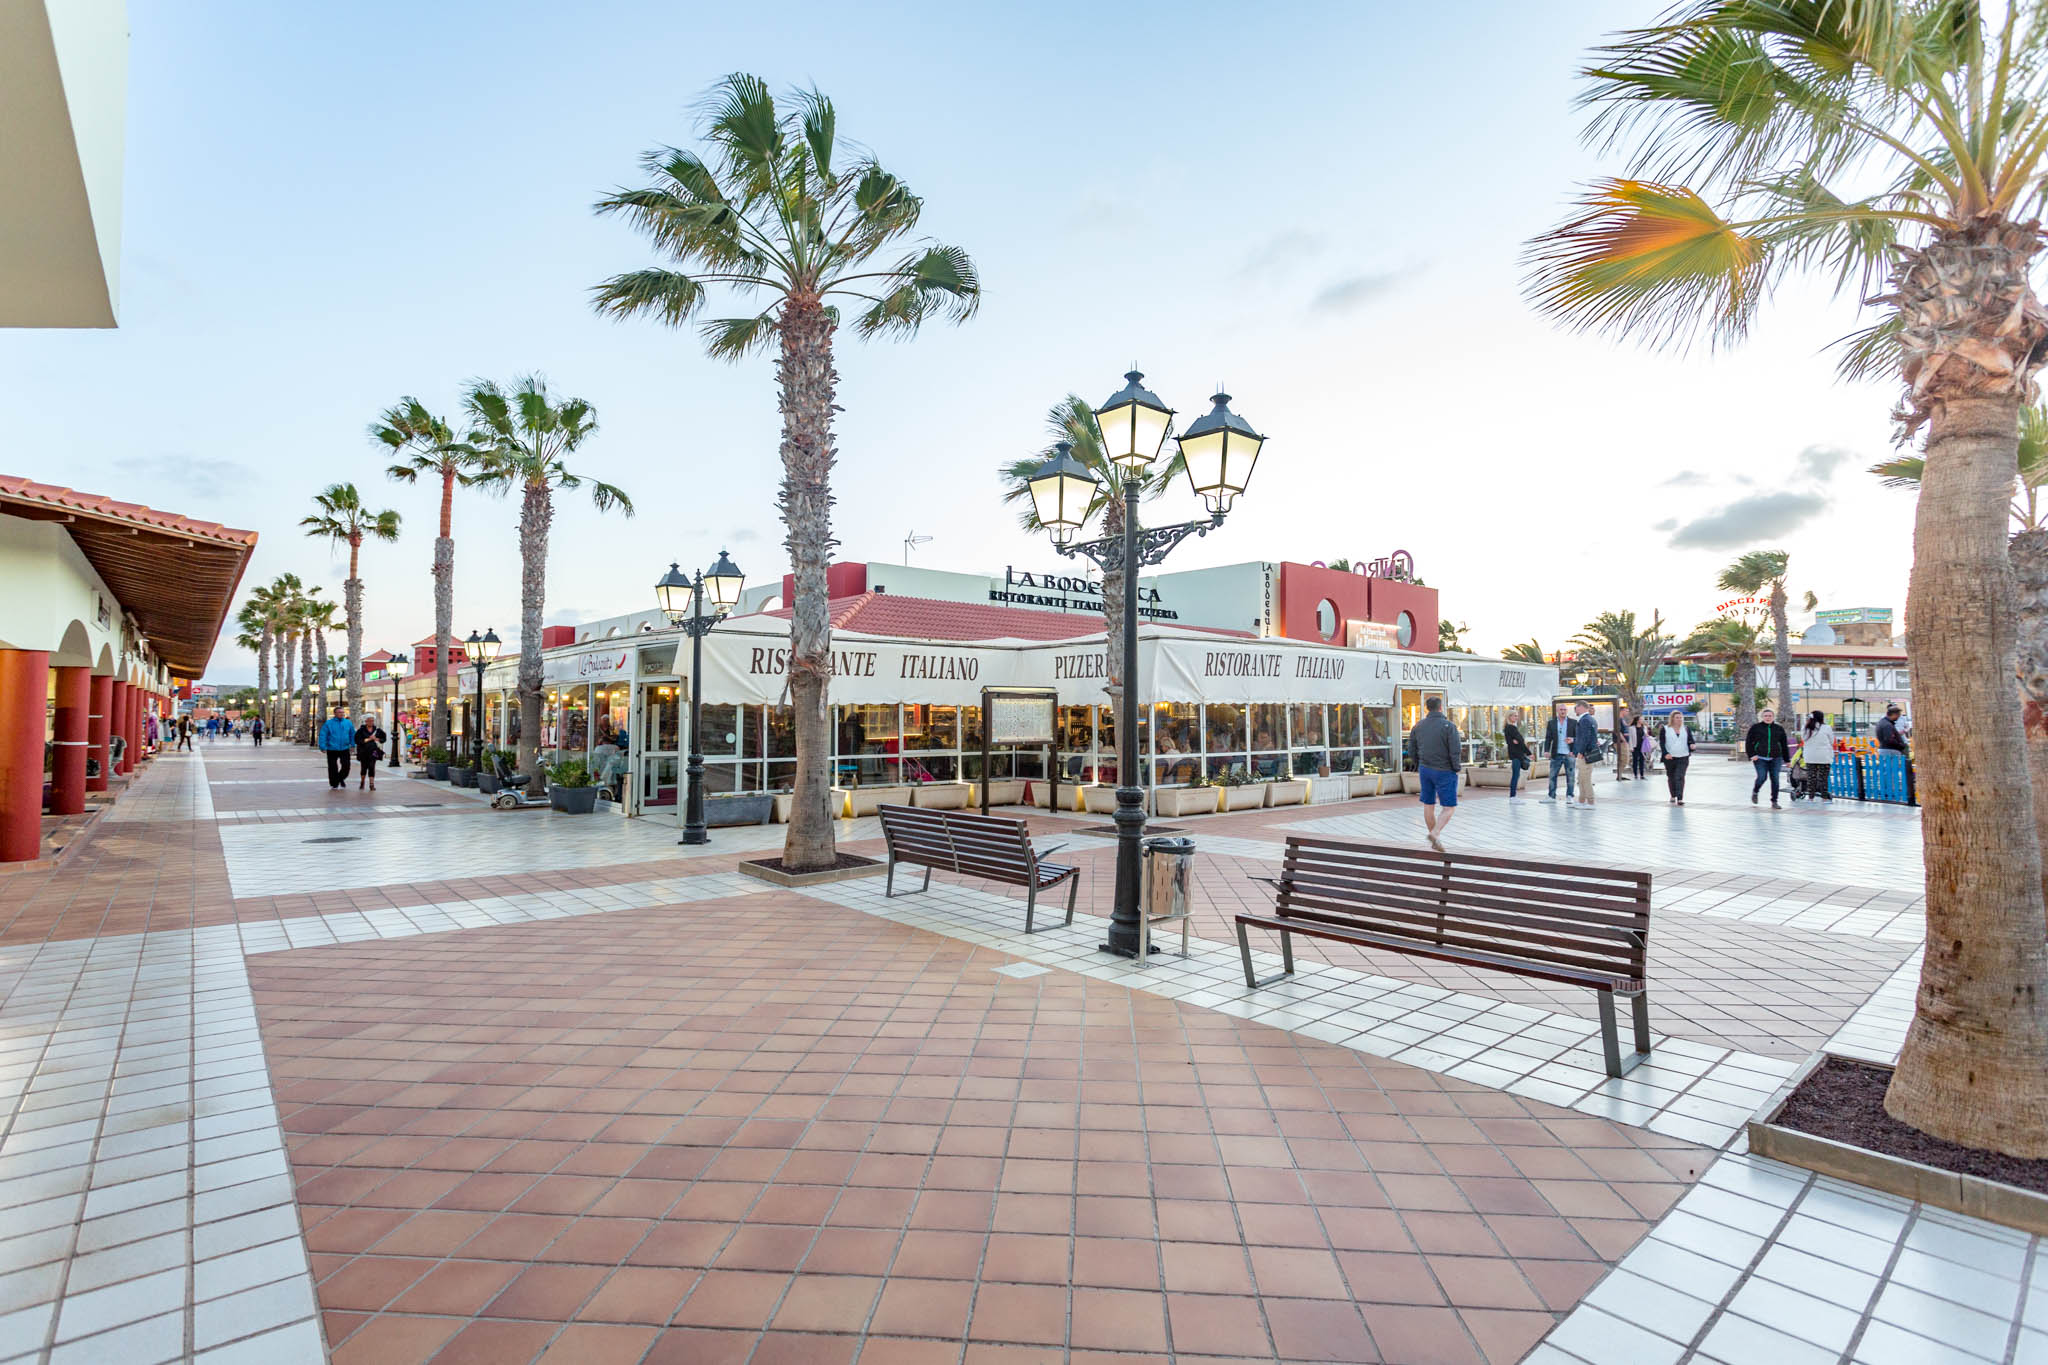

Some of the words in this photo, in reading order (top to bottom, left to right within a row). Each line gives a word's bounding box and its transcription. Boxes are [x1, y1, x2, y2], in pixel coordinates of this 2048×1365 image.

[1006, 565, 1037, 588] LA
[989, 590, 1067, 608] RISTORANTE
[900, 654, 979, 681] ITALIANO
[1055, 653, 1110, 679] PIZZERI
[1204, 652, 1282, 678] RISTORANTE
[1295, 655, 1345, 680] ITALIANO
[1375, 655, 1391, 680] LA
[1402, 661, 1463, 683] BODEGUITA
[1498, 669, 1526, 688] PIZZERIA
[1657, 694, 1694, 705] SHOP
